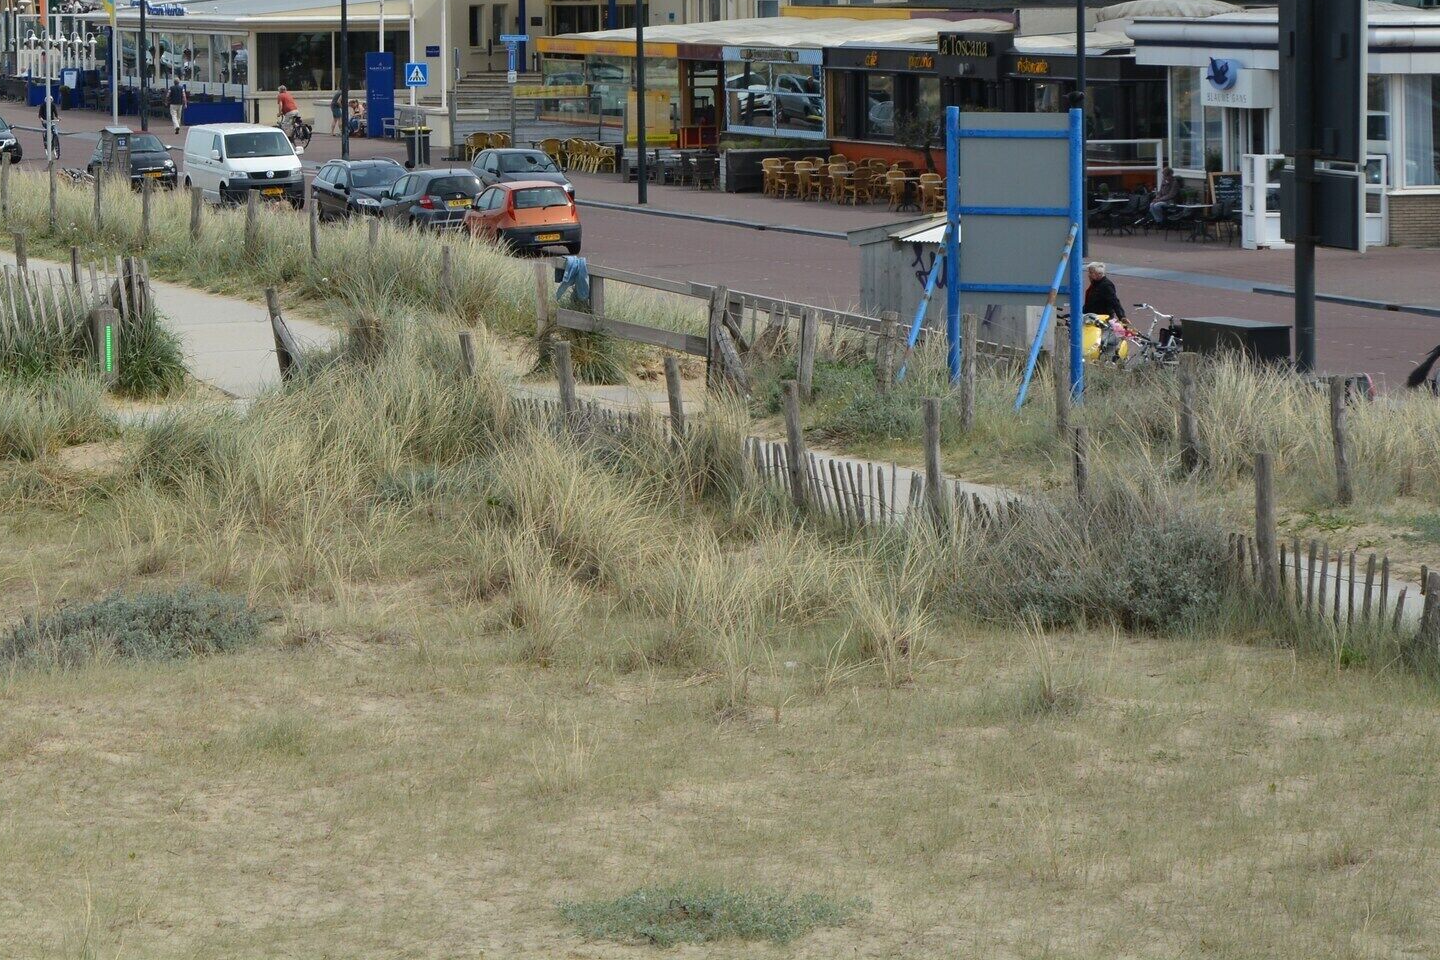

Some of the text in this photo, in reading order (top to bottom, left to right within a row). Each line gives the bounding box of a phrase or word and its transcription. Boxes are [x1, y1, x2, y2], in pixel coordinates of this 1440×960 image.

[937, 34, 988, 58] La Toscana
[1207, 92, 1247, 104] BLAUWE GANS
